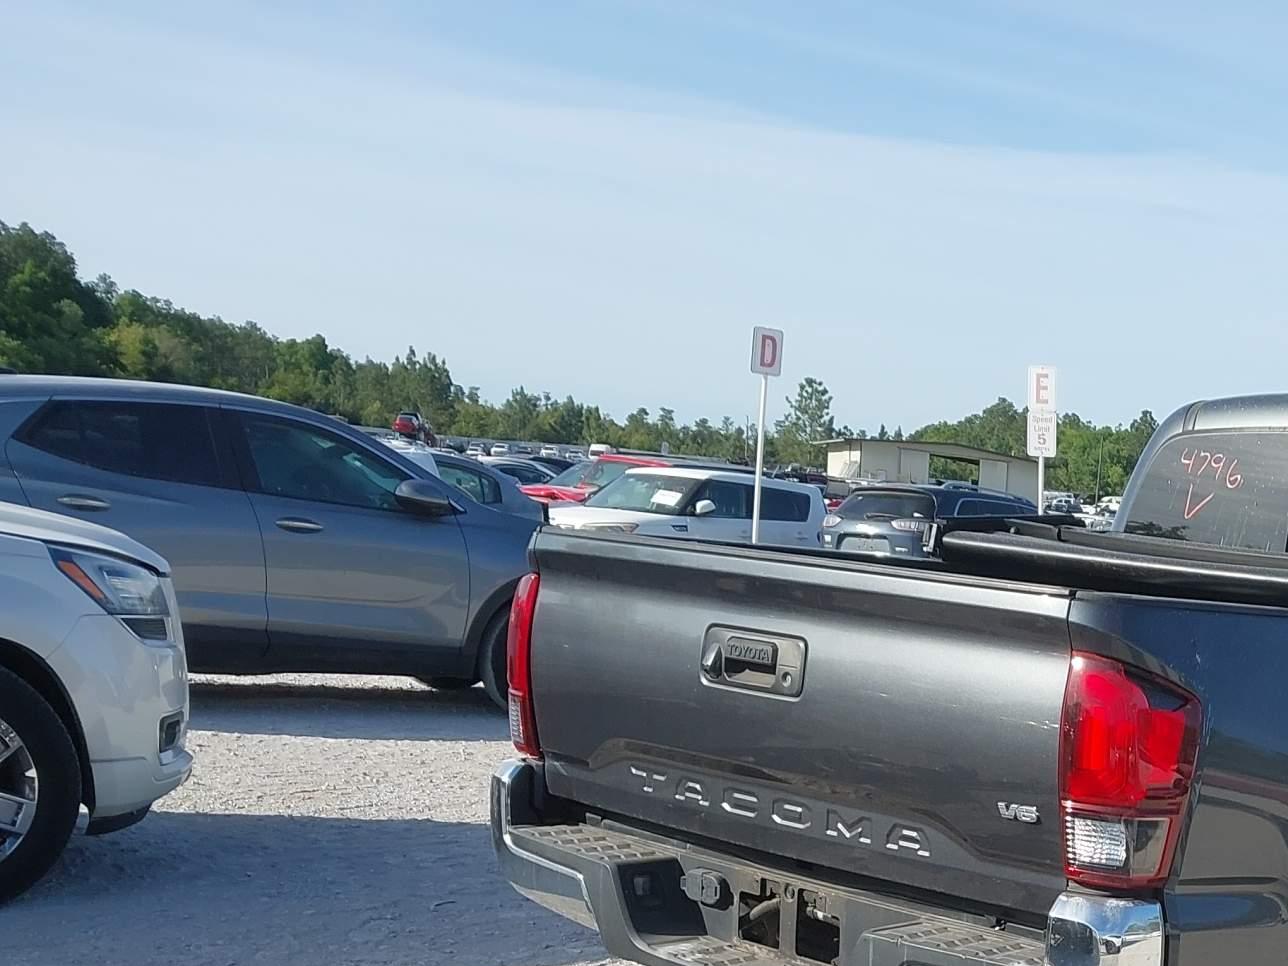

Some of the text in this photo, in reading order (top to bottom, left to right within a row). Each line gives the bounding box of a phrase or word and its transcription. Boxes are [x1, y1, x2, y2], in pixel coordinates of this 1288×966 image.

[760, 334, 777, 368] D
[1036, 373, 1049, 404] E
[1037, 433, 1047, 446] 5
[1181, 447, 1241, 489] 4796
[728, 643, 770, 662] TOYOTA
[630, 765, 931, 857] TACOMA
[997, 801, 1040, 823] V6
